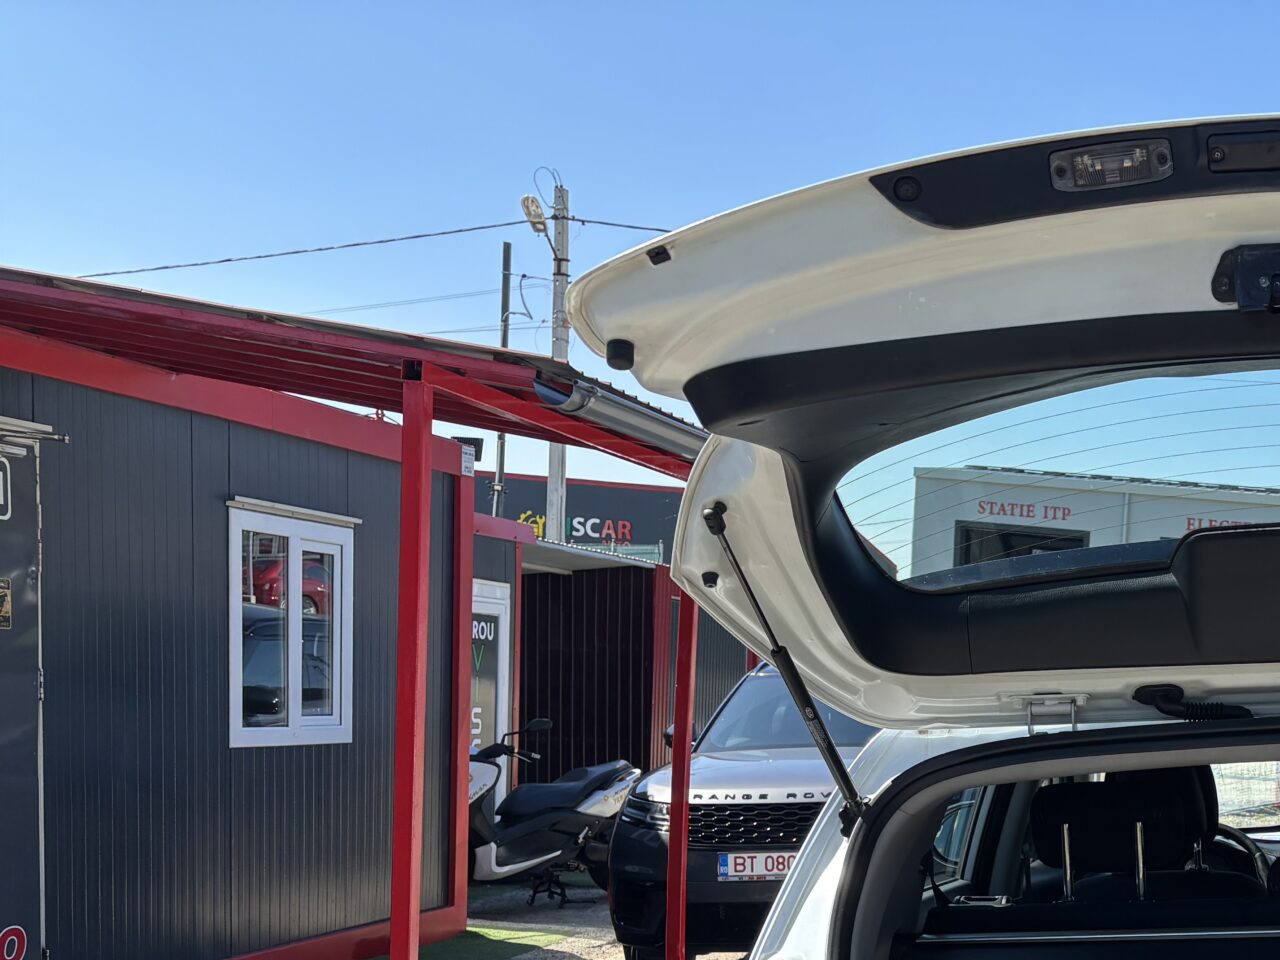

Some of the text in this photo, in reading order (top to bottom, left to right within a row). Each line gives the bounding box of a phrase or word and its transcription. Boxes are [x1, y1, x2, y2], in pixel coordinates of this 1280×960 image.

[978, 501, 1071, 520] STATIE ITP
[566, 516, 632, 540] ISCAR
[472, 620, 494, 641] ROU
[692, 791, 832, 801] RANGE ROV
[734, 855, 757, 873] BT
